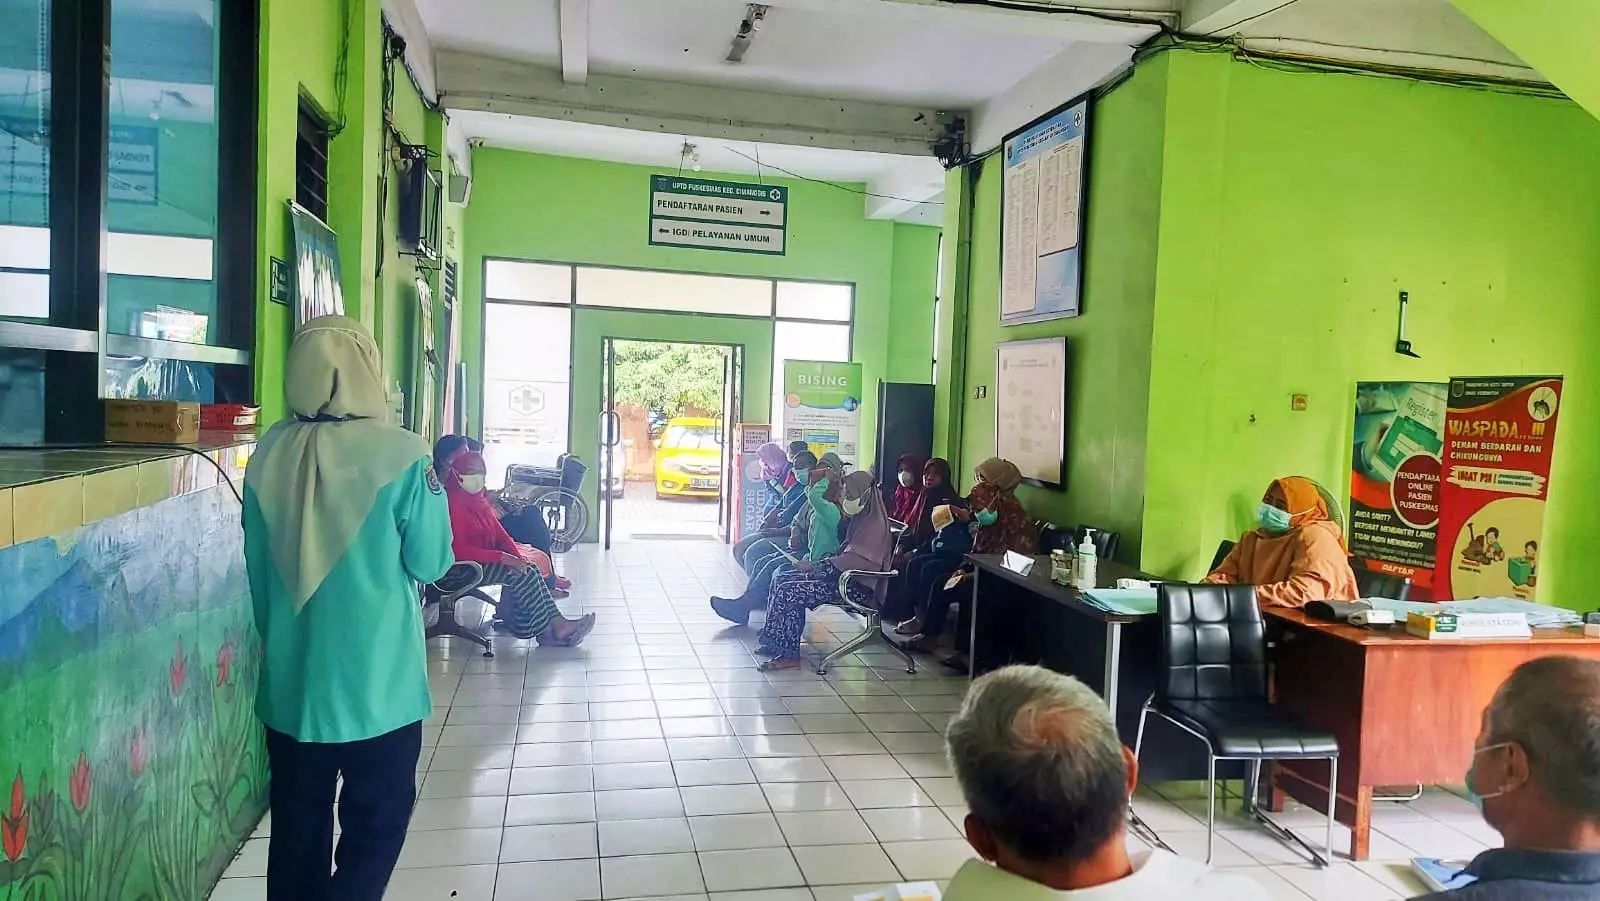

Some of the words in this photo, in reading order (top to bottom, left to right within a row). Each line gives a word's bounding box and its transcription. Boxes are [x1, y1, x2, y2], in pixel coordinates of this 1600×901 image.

[657, 199, 714, 213] PENDAFTARAN
[715, 205, 743, 216] PASIEN
[692, 230, 741, 241] PELAYANAN
[744, 233, 770, 244] UMUM
[798, 374, 847, 386] BISING
[1451, 440, 1479, 450] DEMAM
[1480, 443, 1522, 453] BERDARAH
[1450, 452, 1503, 462] CHIKUNGUNYA
[1397, 471, 1440, 482] PENDAFTARA
[1407, 483, 1434, 492] ONLINE
[1407, 492, 1432, 501] PASIEN
[746, 489, 756, 532] SEGAR
[1399, 500, 1439, 512] PUSKESMAS
[1381, 563, 1415, 575] DAFTAR
